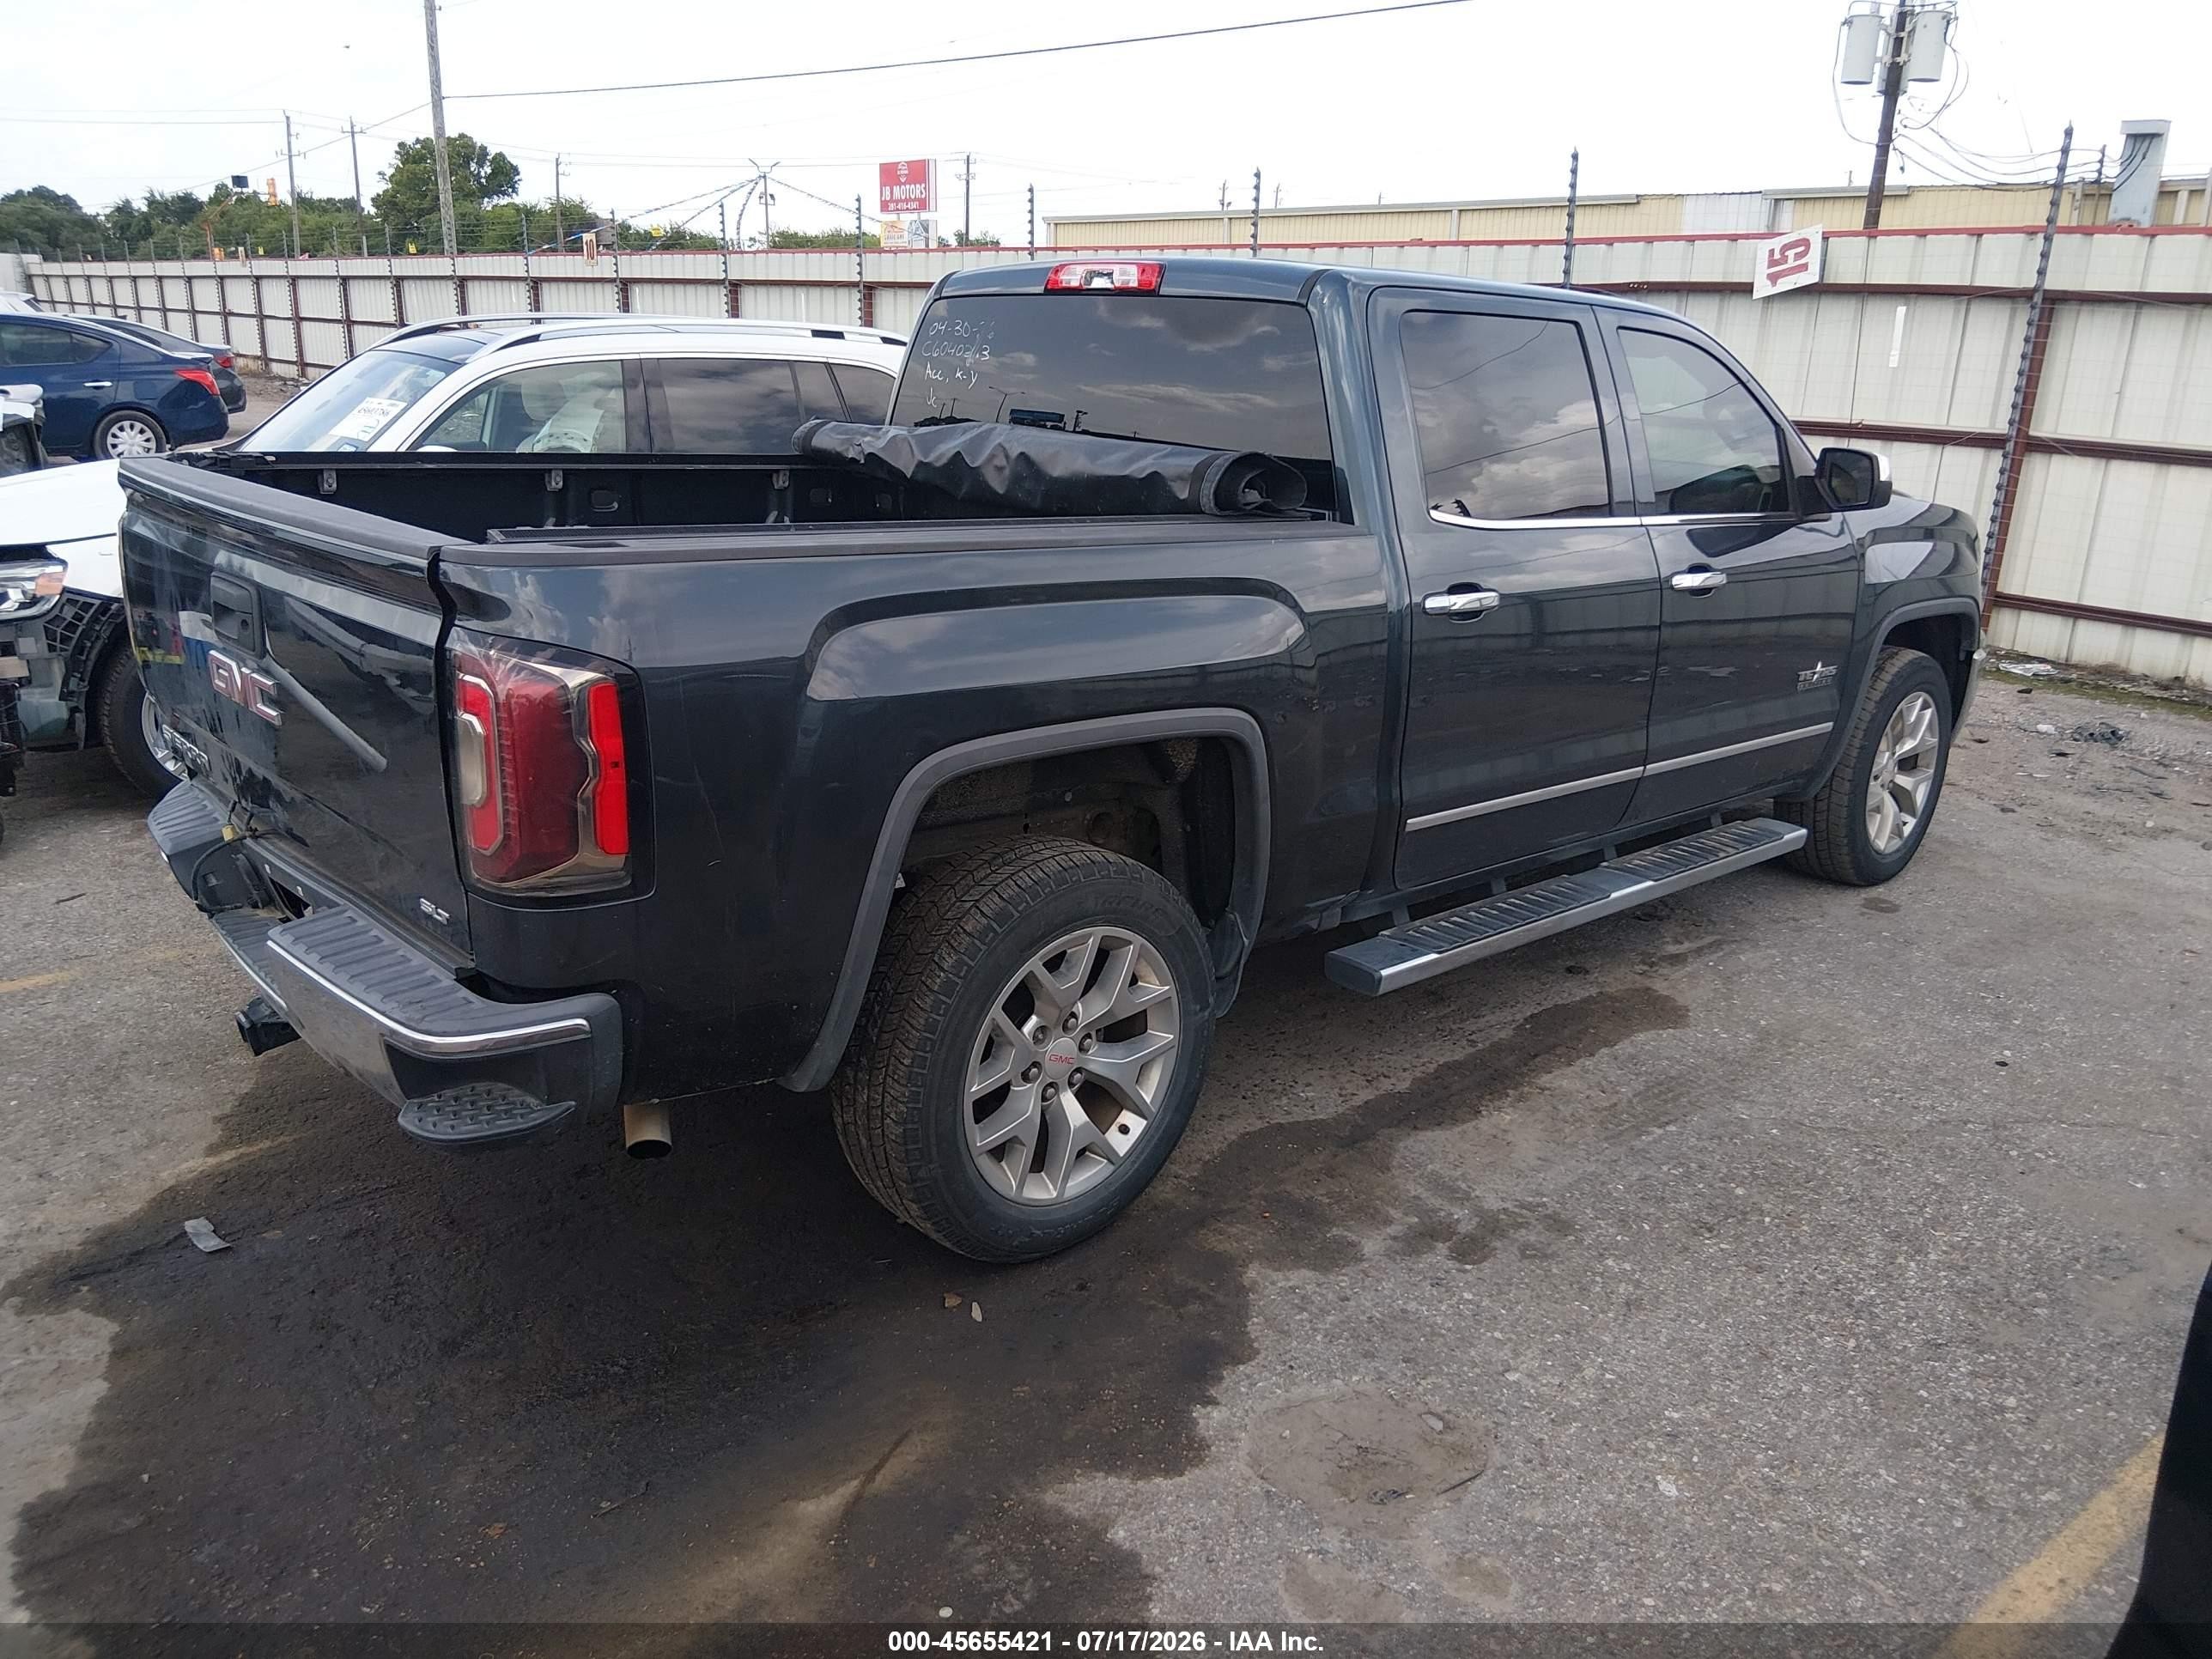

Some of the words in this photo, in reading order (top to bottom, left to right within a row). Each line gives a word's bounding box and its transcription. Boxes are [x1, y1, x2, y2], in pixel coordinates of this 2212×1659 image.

[881, 185, 891, 201] JB
[893, 183, 927, 200] MOTORS
[585, 239, 595, 260] 10
[1765, 237, 1812, 288] 15
[207, 649, 283, 726] GMC
[419, 897, 450, 925] SLT
[1048, 1054, 1075, 1065] GMC
